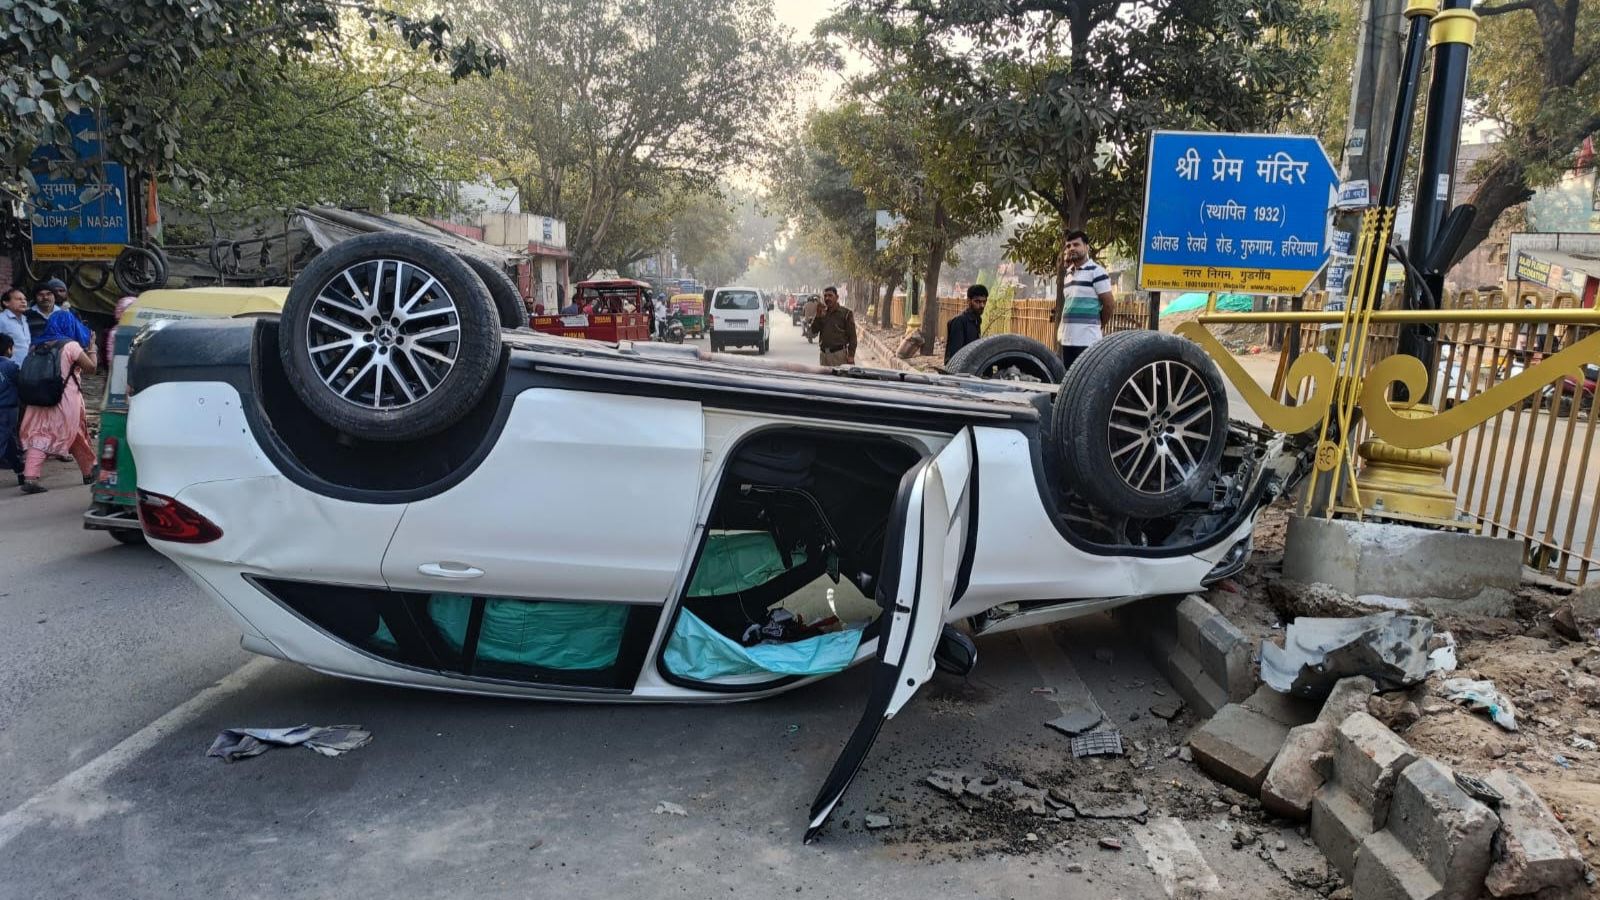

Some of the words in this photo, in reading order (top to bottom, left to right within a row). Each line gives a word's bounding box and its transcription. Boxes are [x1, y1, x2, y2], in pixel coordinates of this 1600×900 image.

[1175, 147, 1201, 181] श्री
[1212, 149, 1244, 182] प्रेम
[1256, 151, 1309, 184] मंदिर
[41, 183, 77, 201] सुभाष
[87, 216, 123, 228] NAGAR
[1200, 199, 1247, 225] (स्थापित
[1253, 204, 1286, 228] 1932)
[1151, 230, 1180, 251] ओलड
[1187, 231, 1208, 253] रेलवे
[1281, 235, 1319, 257] हरियाणा
[1183, 269, 1201, 278] नगर
